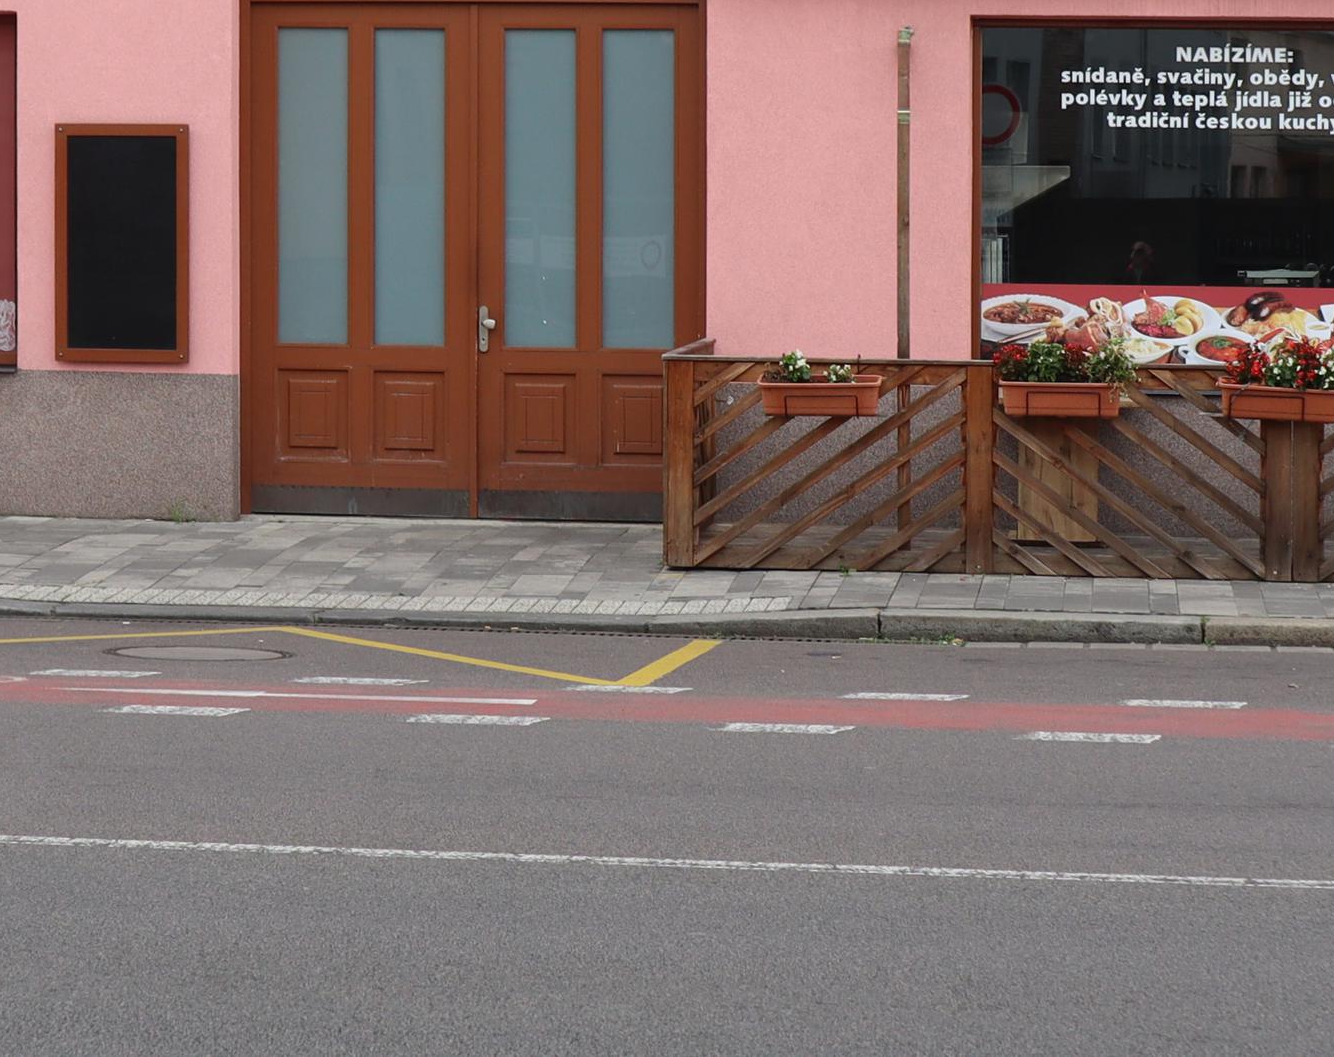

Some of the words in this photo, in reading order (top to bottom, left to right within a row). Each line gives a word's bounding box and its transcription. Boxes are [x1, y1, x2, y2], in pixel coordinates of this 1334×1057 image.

[1175, 44, 1294, 63] NABÍZÍME:
[1060, 67, 1151, 87] snídaně,
[1157, 68, 1244, 90] svačiny,
[1249, 69, 1325, 90] obědy,
[1060, 89, 1147, 110] polévky
[1152, 94, 1167, 107] a
[1172, 90, 1229, 111] teplá
[1234, 91, 1283, 111] jídla
[1286, 91, 1313, 112] již
[1107, 112, 1189, 130] tradiční
[1195, 113, 1272, 131] českou
